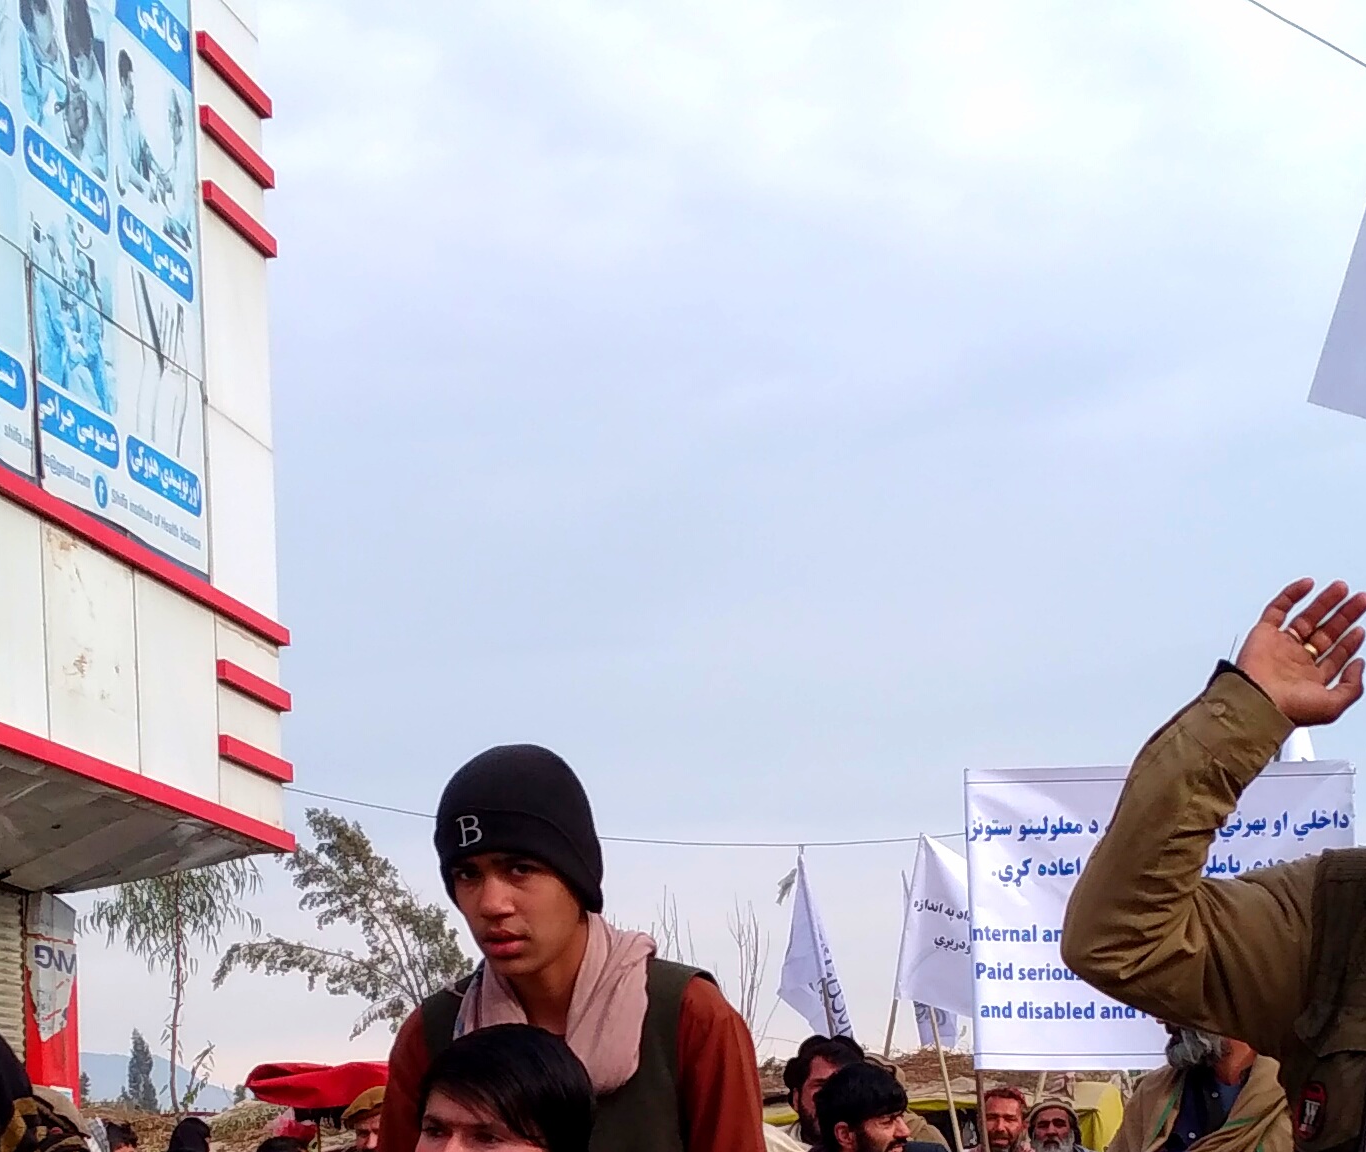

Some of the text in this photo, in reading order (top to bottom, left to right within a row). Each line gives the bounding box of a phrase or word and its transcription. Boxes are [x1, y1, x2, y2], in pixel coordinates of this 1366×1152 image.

[455, 815, 483, 847] B
[1271, 810, 1288, 838] او
[1293, 809, 1350, 842] داخلي
[975, 962, 1013, 980] Paid
[980, 1001, 1012, 1019] and
[1017, 1001, 1095, 1020] disabled
